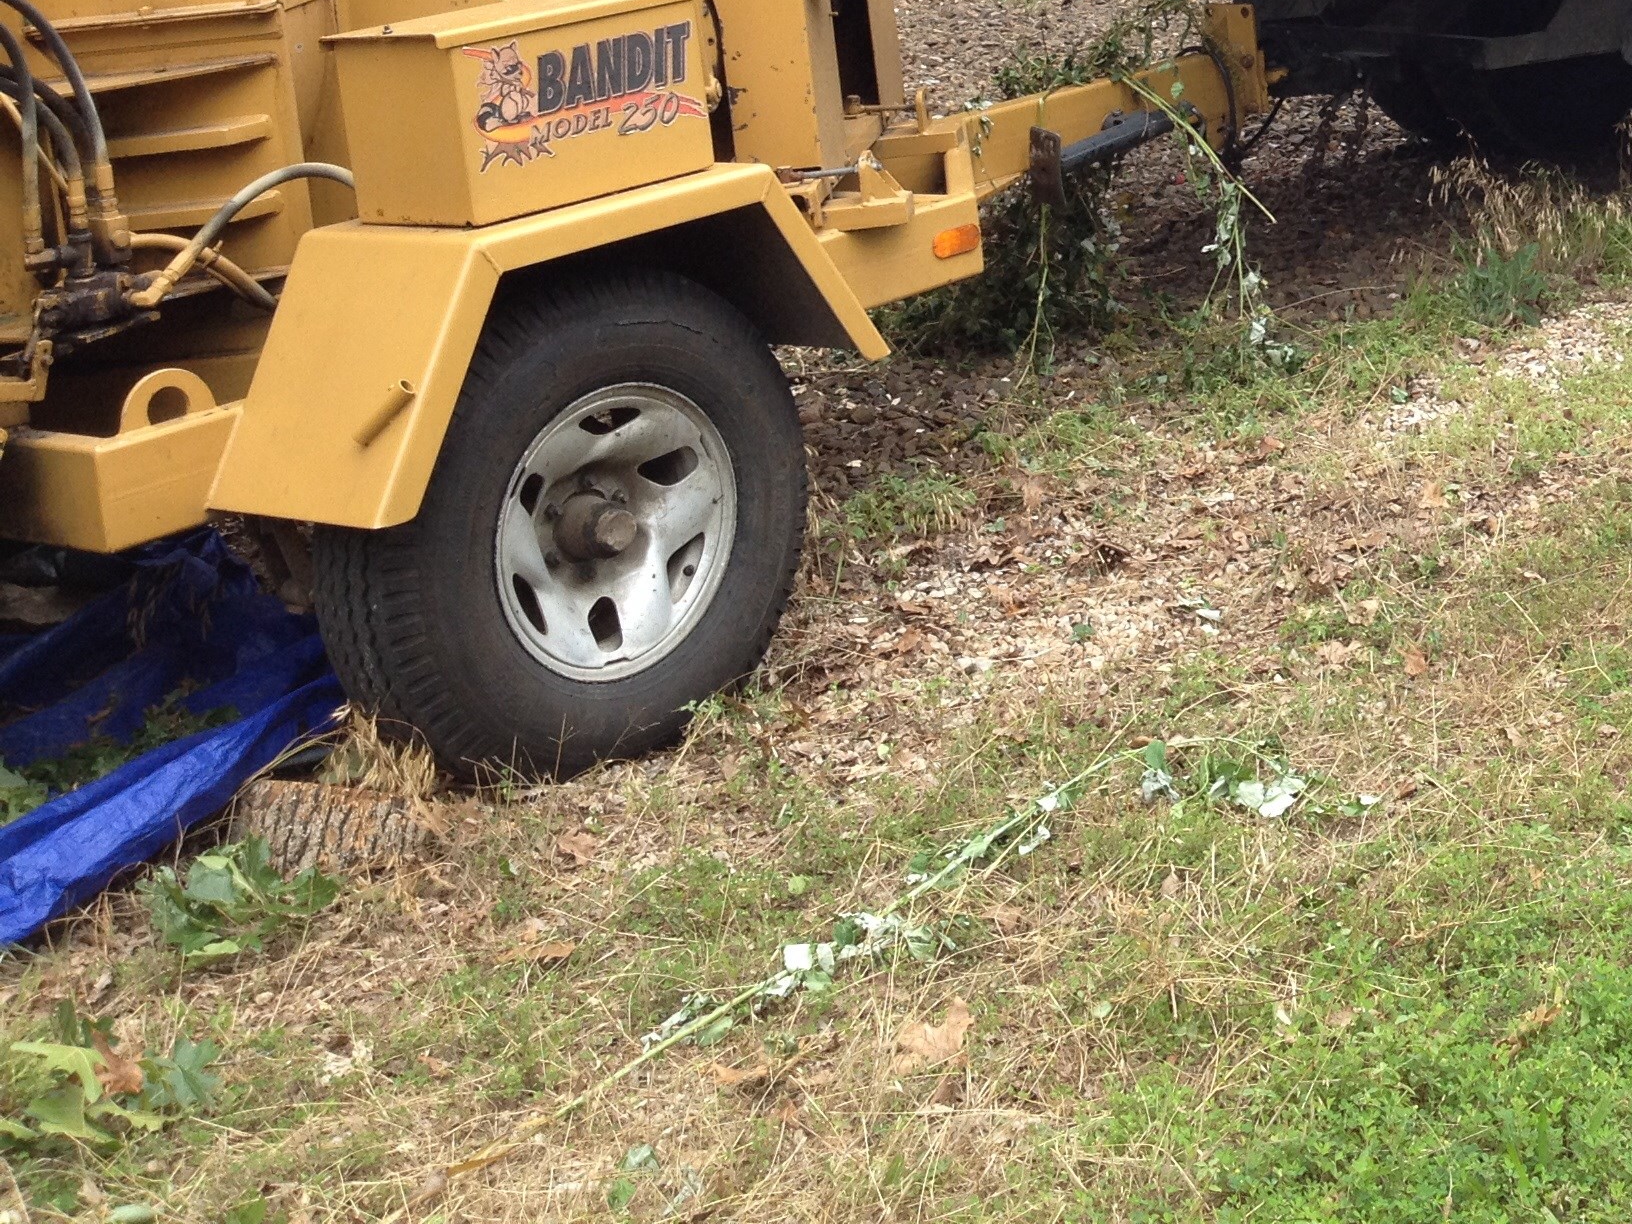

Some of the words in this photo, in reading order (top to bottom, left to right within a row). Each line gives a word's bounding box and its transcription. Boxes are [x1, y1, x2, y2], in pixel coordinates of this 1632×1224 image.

[537, 21, 693, 115] BANDIT
[530, 106, 613, 147] MODEL
[617, 91, 680, 136] 250
